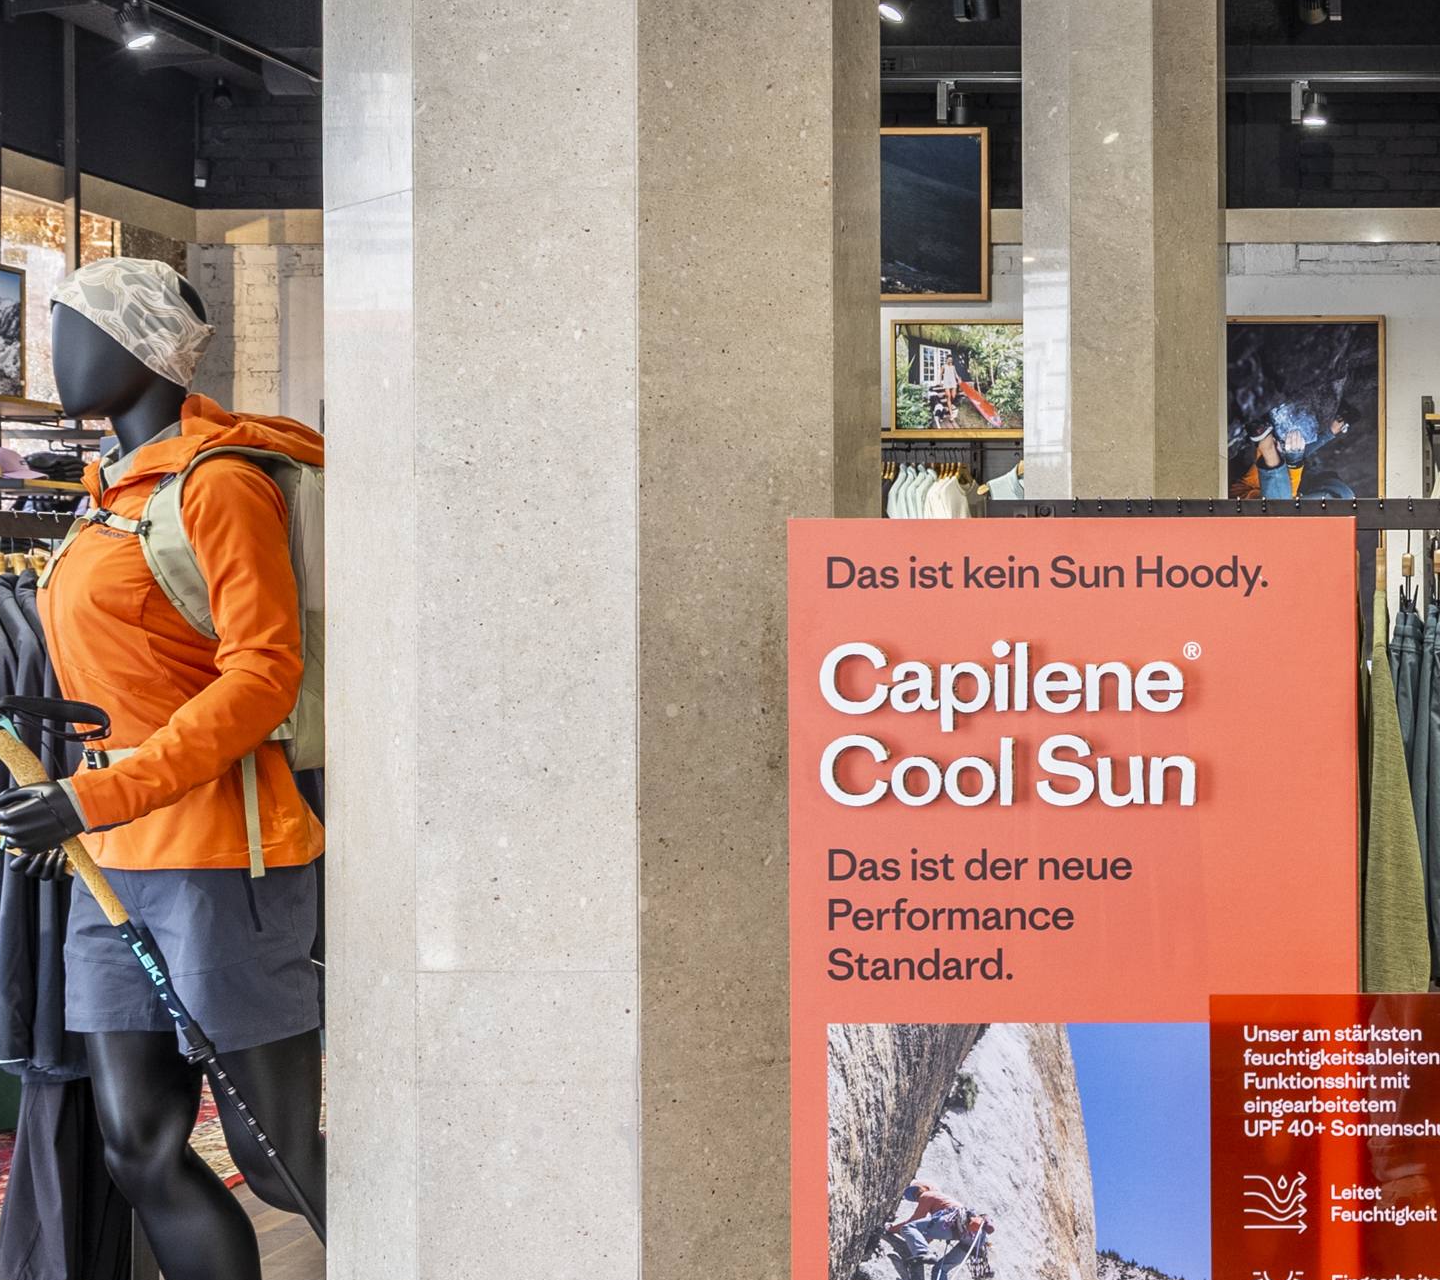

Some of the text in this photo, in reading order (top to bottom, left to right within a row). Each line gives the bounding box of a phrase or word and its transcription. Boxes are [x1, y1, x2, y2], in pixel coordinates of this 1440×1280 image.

[827, 556, 1267, 596] Das ist kein Sun Hoody.
[820, 735, 1195, 806] Cool Sun
[829, 848, 1132, 881] Das ist der neue
[829, 898, 1074, 931] Performance
[132, 941, 166, 986] LEKI
[828, 948, 1013, 980] Standard.
[1244, 1025, 1422, 1042] Unser am stärksten
[1244, 1072, 1410, 1089] Funktionsshirt mit
[1244, 1096, 1396, 1117] eingearbeitetem
[1245, 1120, 1284, 1136] UPF
[1288, 1120, 1325, 1136] 40+
[1331, 1184, 1381, 1200] Leitet
[1331, 1206, 1437, 1226] Feuchtigkeit
